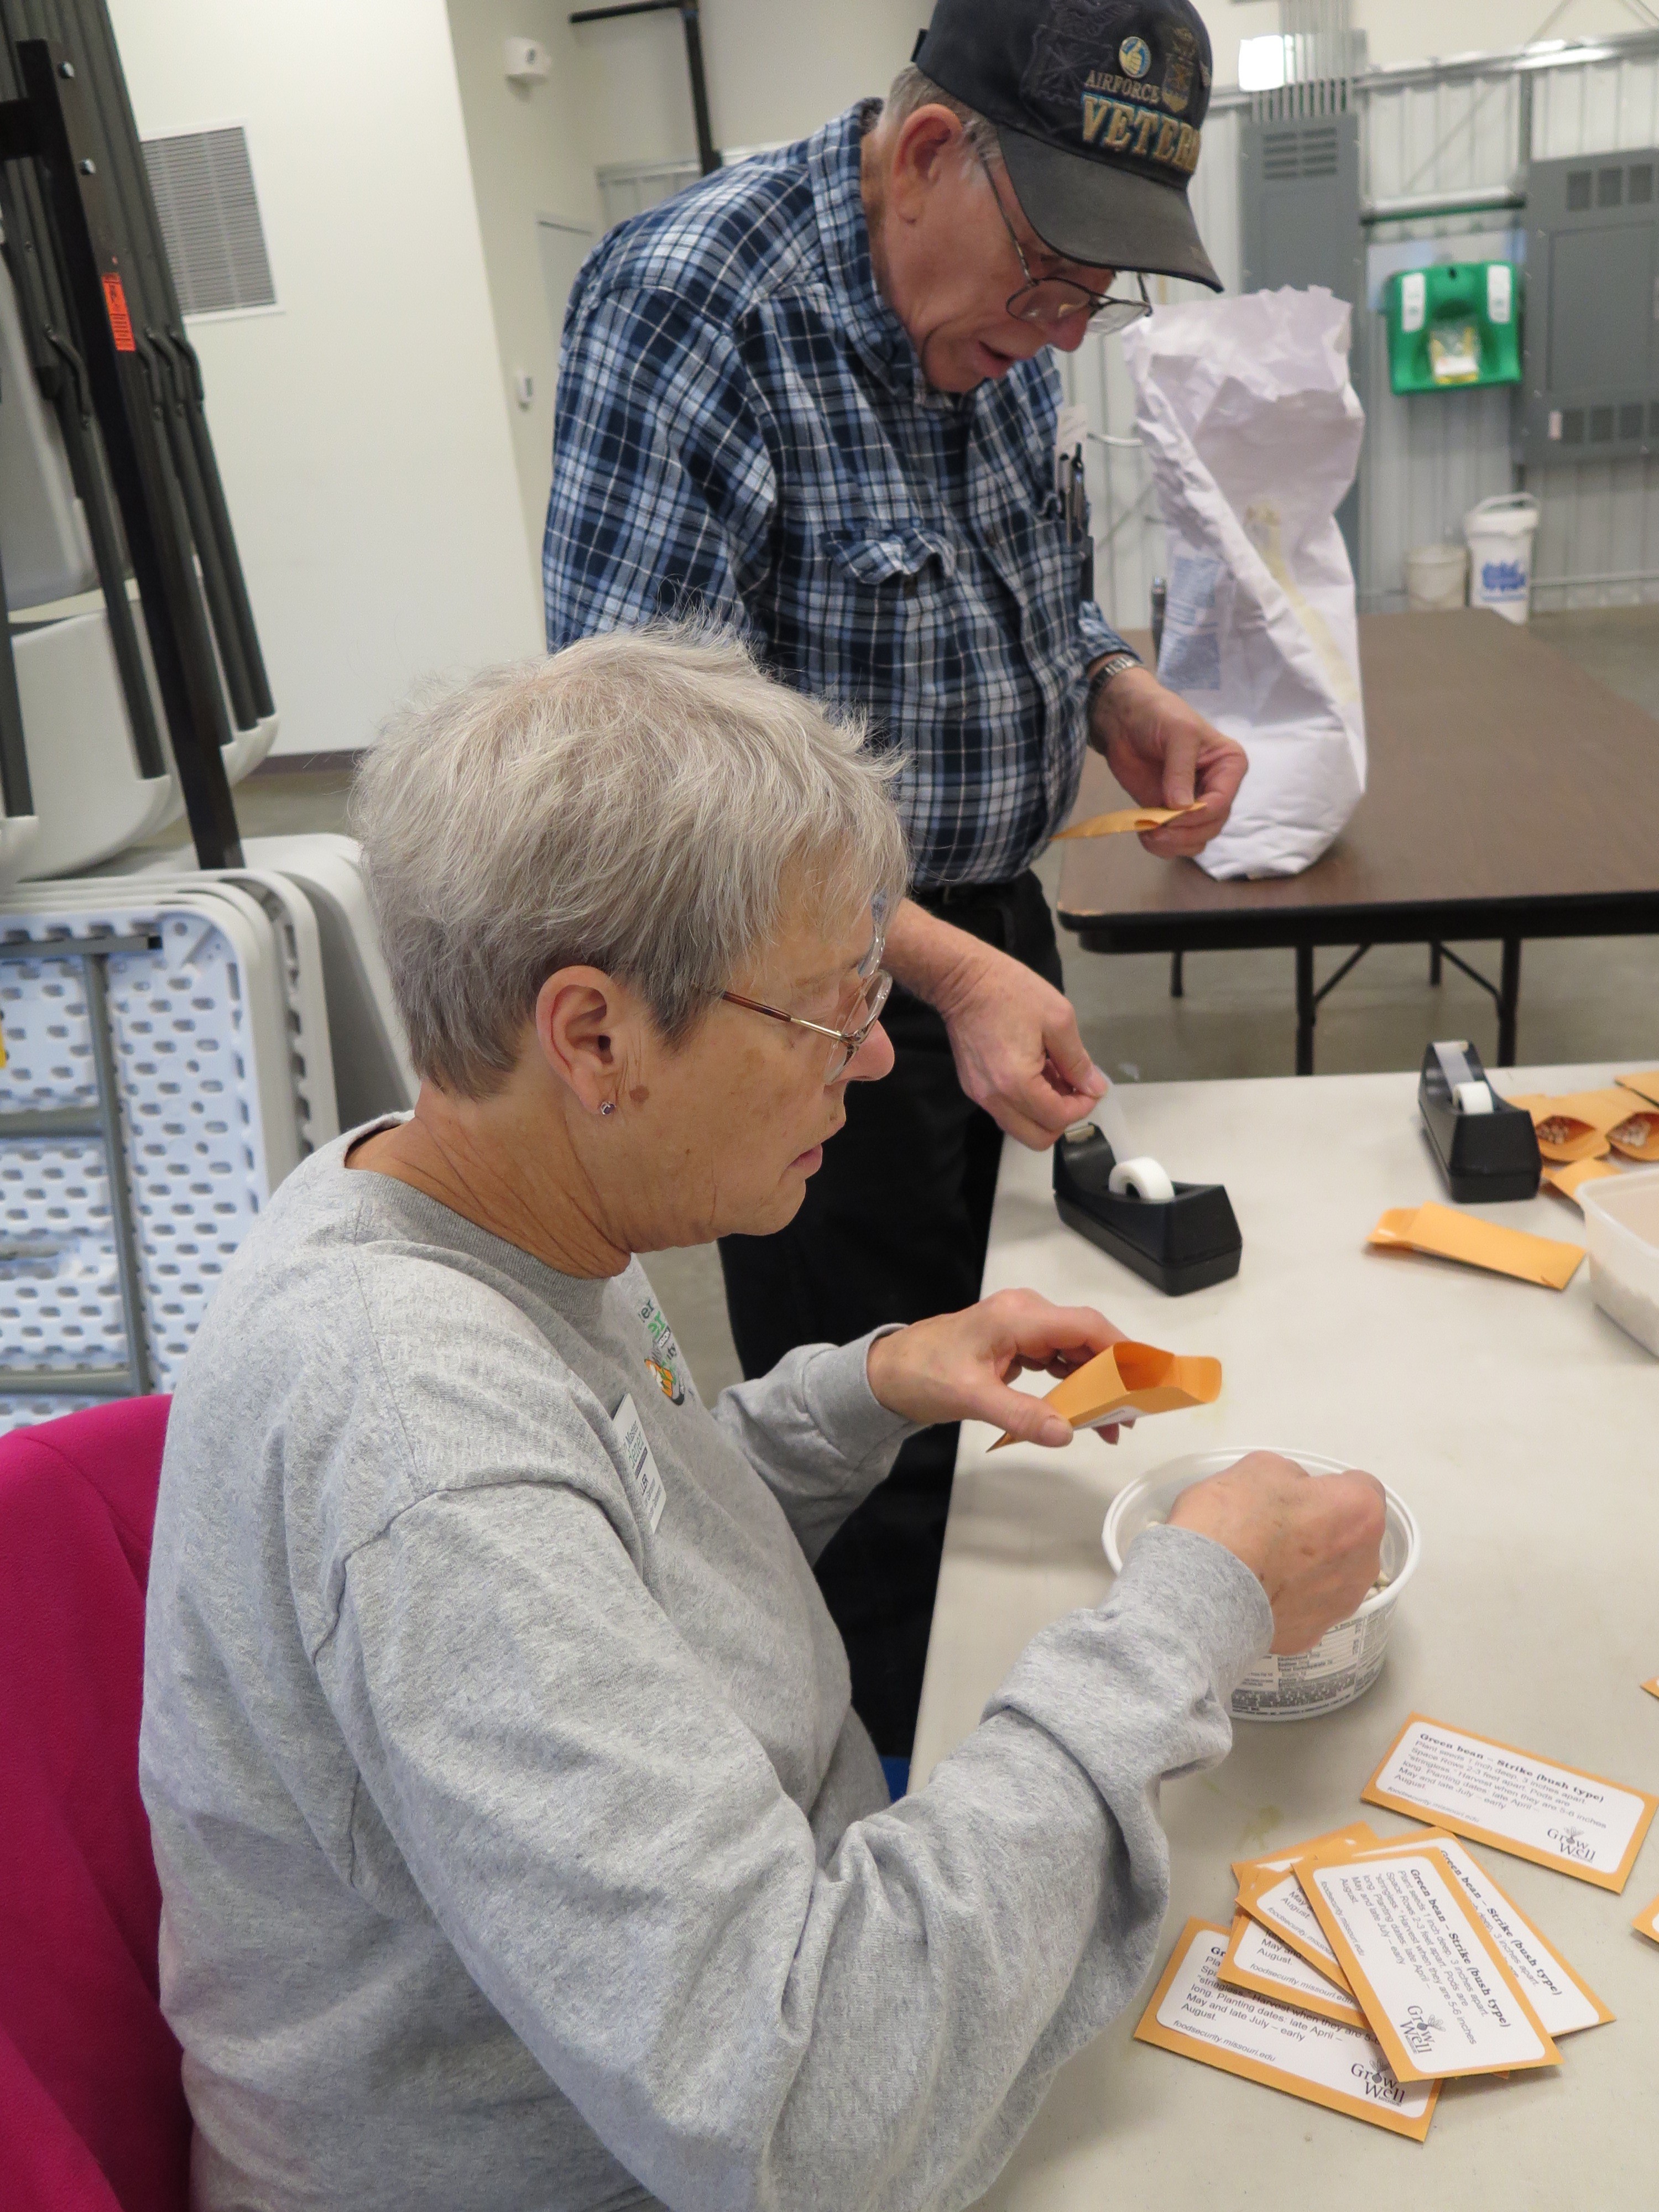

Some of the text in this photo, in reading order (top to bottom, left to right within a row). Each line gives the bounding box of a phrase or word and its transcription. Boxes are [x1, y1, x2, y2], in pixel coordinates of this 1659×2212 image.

[1084, 69, 1160, 105] AIRFORCE
[1320, 1881, 1365, 1956] foodsecurity.missouri.edu
[1351, 1876, 1364, 1892] May
[1360, 1893, 1375, 1907] and
[1369, 1907, 1381, 1922] late
[1377, 1922, 1391, 1938] July
[1390, 1945, 1406, 1965] early
[1373, 1893, 1394, 1922] Planting
[1404, 1948, 1417, 1963] late
[1413, 1964, 1430, 1982] April
[1386, 1872, 1403, 1895] Space
[1400, 1896, 1416, 1916] Rows
[1412, 1917, 1426, 1929] 2-3
[1420, 1931, 1434, 1946] feet
[1443, 1970, 1460, 1991] Pods
[1456, 1992, 1469, 2006] are
[1397, 1870, 1414, 1889] Plant
[1408, 1890, 1426, 1911] seeds
[1426, 1919, 1441, 1935] inch
[1454, 1966, 1474, 1992] inches
[1461, 1876, 1481, 1899] bean
[1486, 1908, 1513, 1937] Strike
[1510, 1939, 1537, 1966] (bush
[1536, 1969, 1562, 1995] type)
[1205, 1955, 1221, 1967] Pla
[1257, 1947, 1293, 1965] August.
[1261, 1938, 1286, 1952] May
[1410, 1869, 1431, 1897] Green
[1428, 1898, 1446, 1922] bean
[1448, 1933, 1471, 1964] Strike
[1467, 1967, 1491, 1996] (bush
[1488, 1999, 1511, 2027] type)
[1499, 1940, 1521, 1964] inches
[1398, 1914, 1421, 1944] Harvest
[1415, 1944, 1432, 1966] when
[1428, 1967, 1443, 1984] they
[1438, 1986, 1451, 2000] are
[1448, 2001, 1462, 2015] 5-6
[1457, 2017, 1477, 2045] inches
[1181, 2003, 1218, 2022] August.
[1186, 1992, 1208, 2007] May
[1209, 2002, 1228, 2013] and
[1229, 2008, 1248, 2020] late
[1249, 2016, 1270, 2029] July
[1280, 2028, 1306, 2042] early
[1191, 1983, 1213, 1998] long.
[1216, 1992, 1255, 2013] Planting
[1257, 2008, 1287, 2022] dates:
[1289, 2018, 1308, 2031] late
[1310, 2026, 1334, 2039] April
[1252, 1994, 1290, 2013] Harvest
[1292, 2009, 1319, 2023] when
[1321, 2018, 1344, 2033] they
[1344, 2028, 1362, 2038] are
[1407, 2005, 1436, 2043] Grow
[1173, 2020, 1276, 2062] foodsecurity.missouri.edu
[1400, 2020, 1432, 2053] Well
[1351, 2063, 1397, 2089] Grow
[1365, 2080, 1406, 2104] Well
